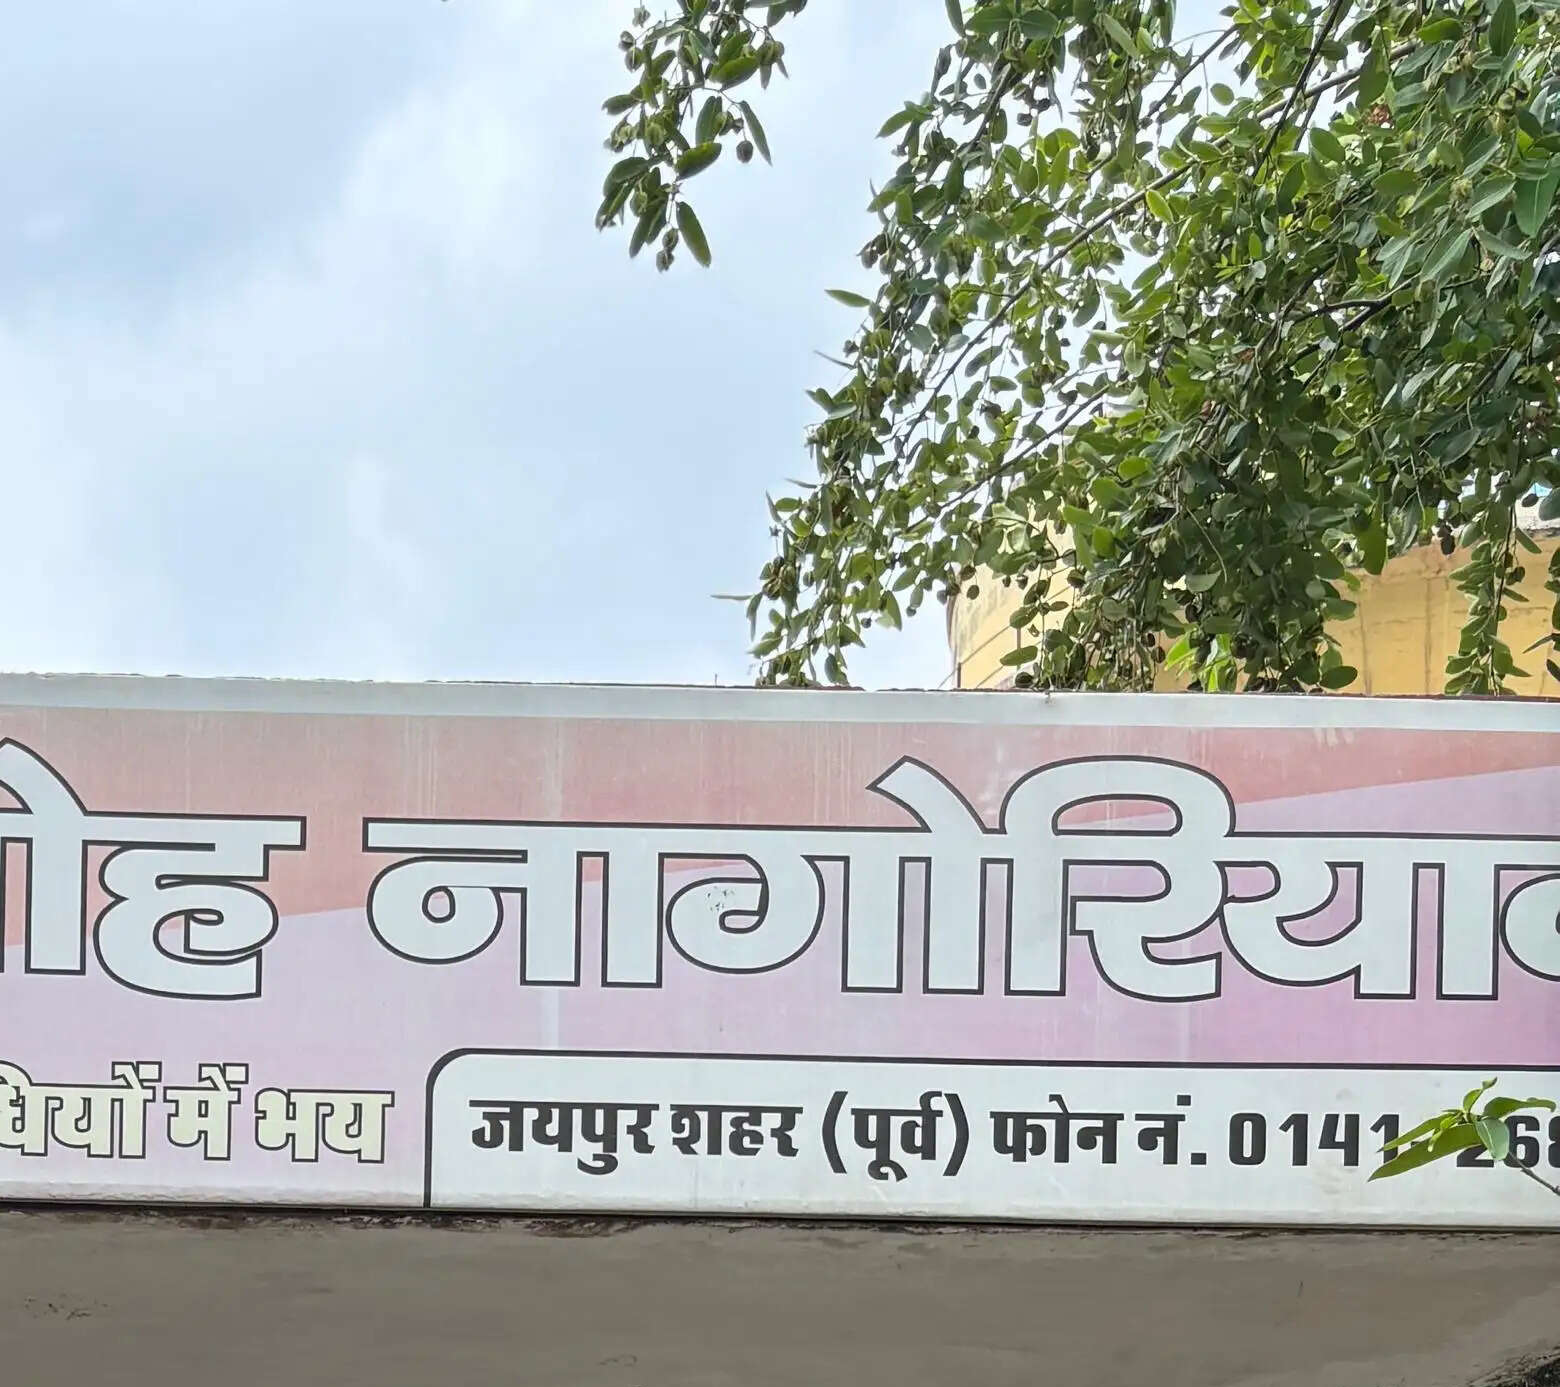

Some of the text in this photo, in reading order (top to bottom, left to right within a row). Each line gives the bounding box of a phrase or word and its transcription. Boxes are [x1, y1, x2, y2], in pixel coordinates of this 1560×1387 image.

[162, 1062, 250, 1163] में
[254, 1088, 396, 1165] भय
[469, 1100, 660, 1176] जयपुर
[670, 1103, 803, 1158] शहर
[821, 1090, 971, 1183] (पूर्व)
[989, 1094, 1124, 1165] फोन
